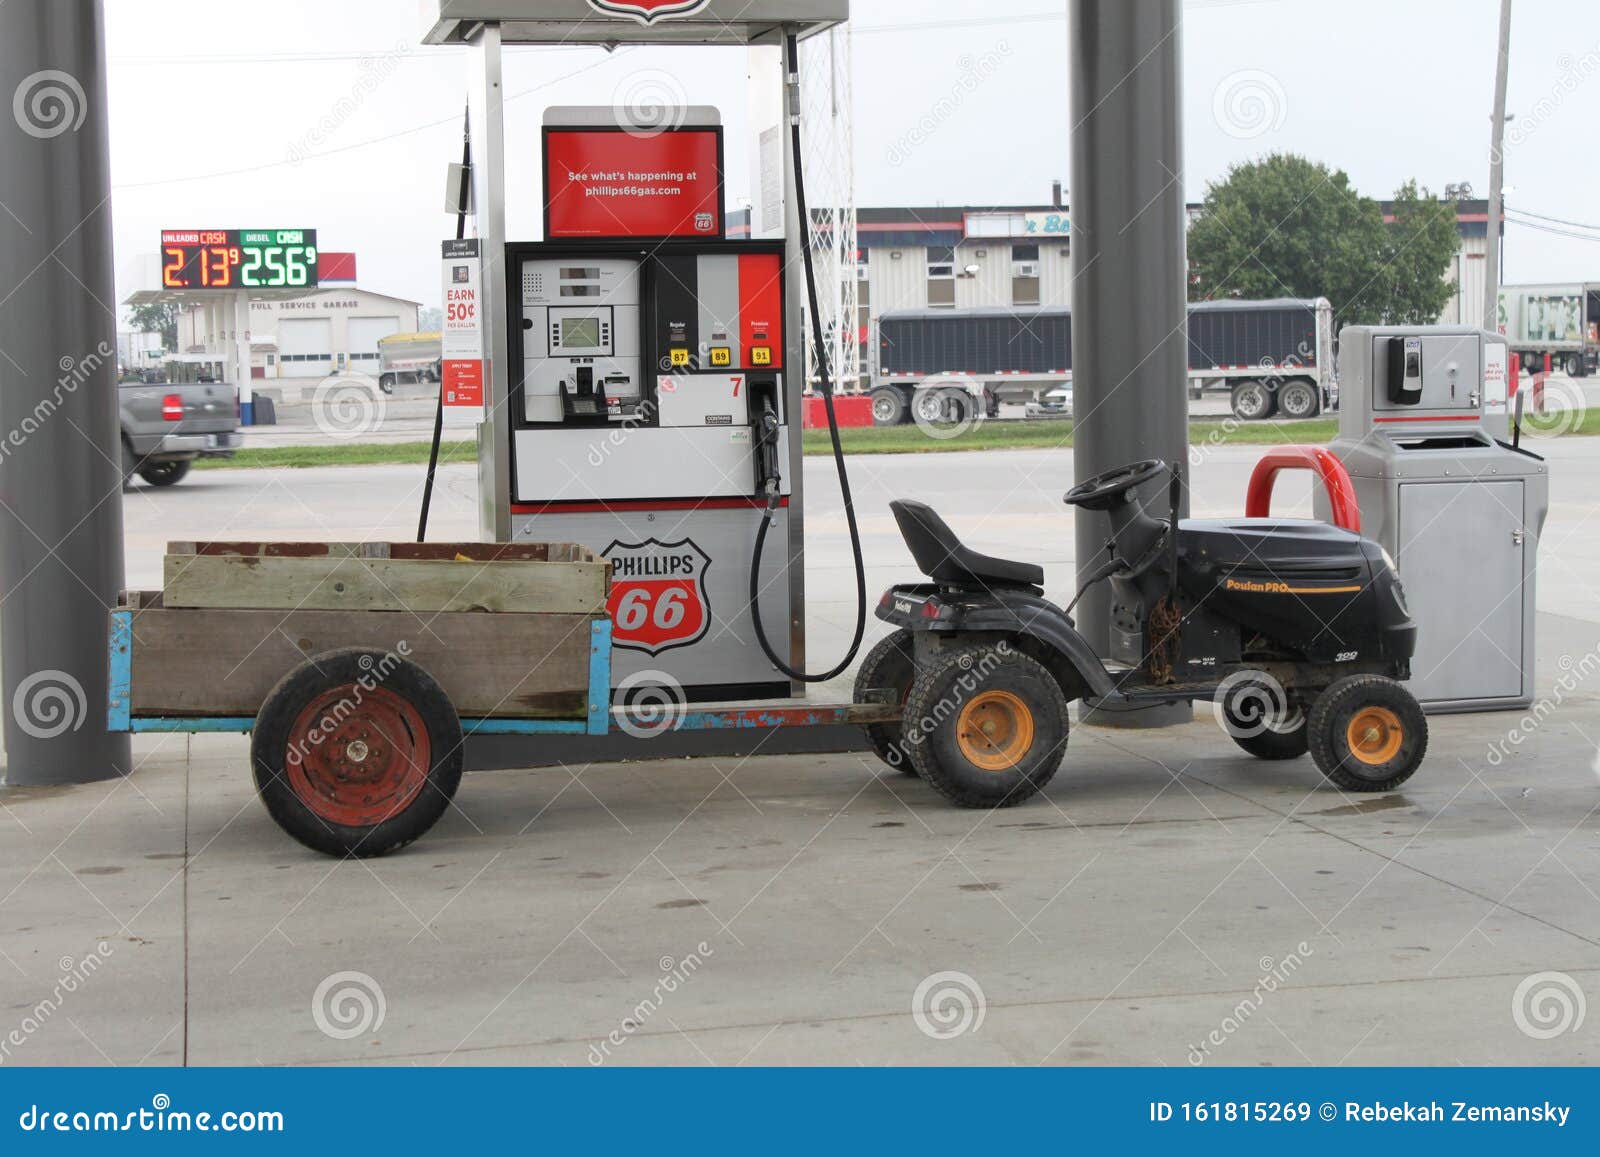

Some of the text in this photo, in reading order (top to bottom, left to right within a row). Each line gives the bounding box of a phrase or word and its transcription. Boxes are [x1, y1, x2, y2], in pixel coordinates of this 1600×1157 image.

[568, 171, 697, 182] See what's happening at
[585, 186, 681, 197] phillips66gas.com
[162, 232, 227, 244] UNLEADED CASH
[246, 231, 303, 244] DIESEL CASH
[447, 290, 475, 301] EARN
[447, 303, 475, 321] 50¢
[674, 353, 685, 362] 87
[715, 352, 727, 361] 89
[756, 351, 768, 360] 91
[730, 377, 742, 397] 7
[611, 555, 693, 576] PHILLIPS
[1226, 579, 1288, 592] Poulan PRO
[616, 587, 688, 630] 66
